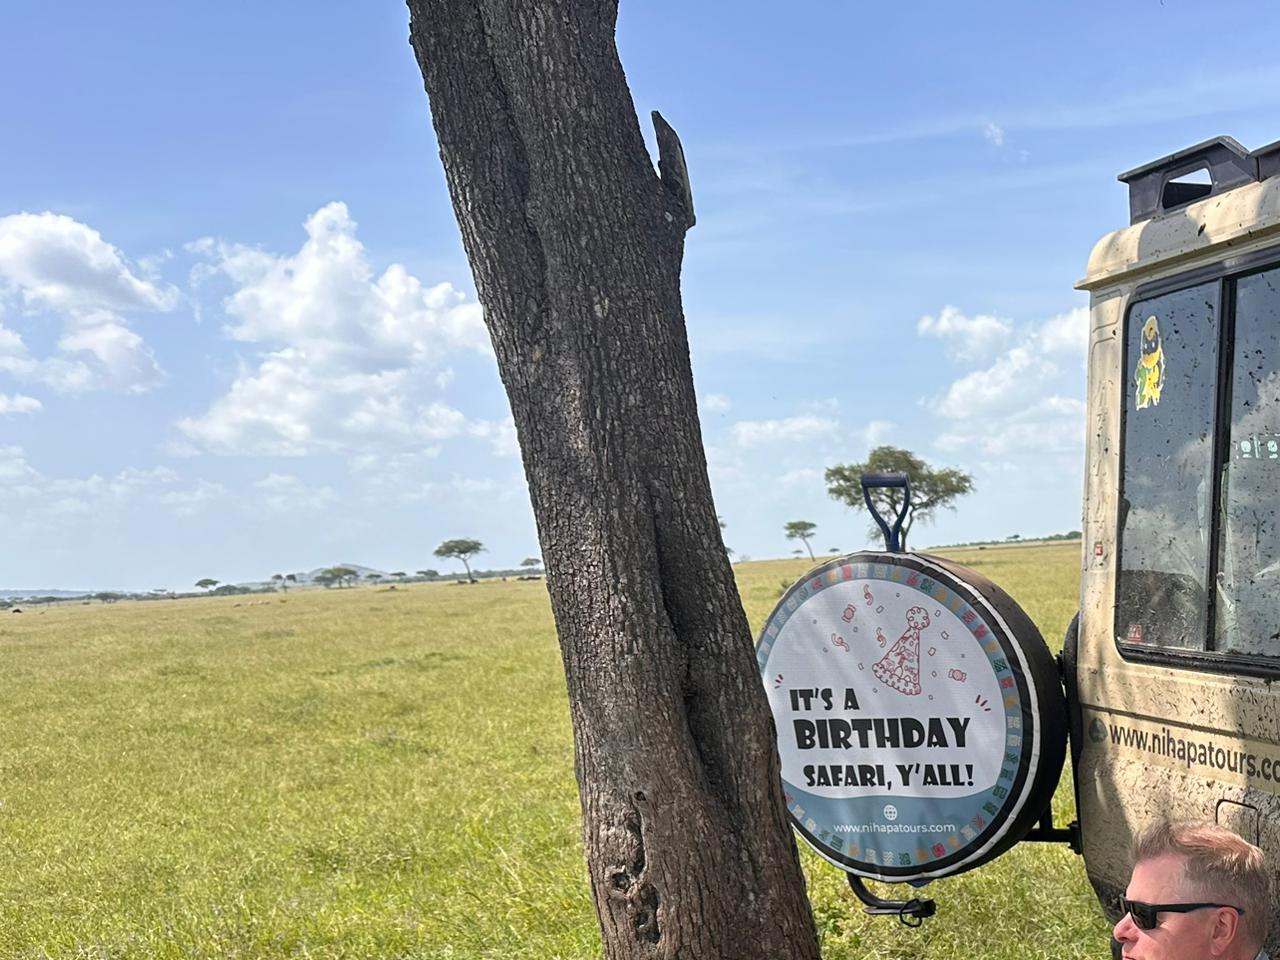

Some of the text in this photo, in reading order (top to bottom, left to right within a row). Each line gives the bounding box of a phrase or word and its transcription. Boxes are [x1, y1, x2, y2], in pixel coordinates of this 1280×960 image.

[789, 687, 860, 711] IT'S A
[793, 717, 971, 750] BIRTHDAY
[803, 763, 975, 790] SAFARI, Y'ALL!
[833, 822, 956, 835] www.nihapatours.com
